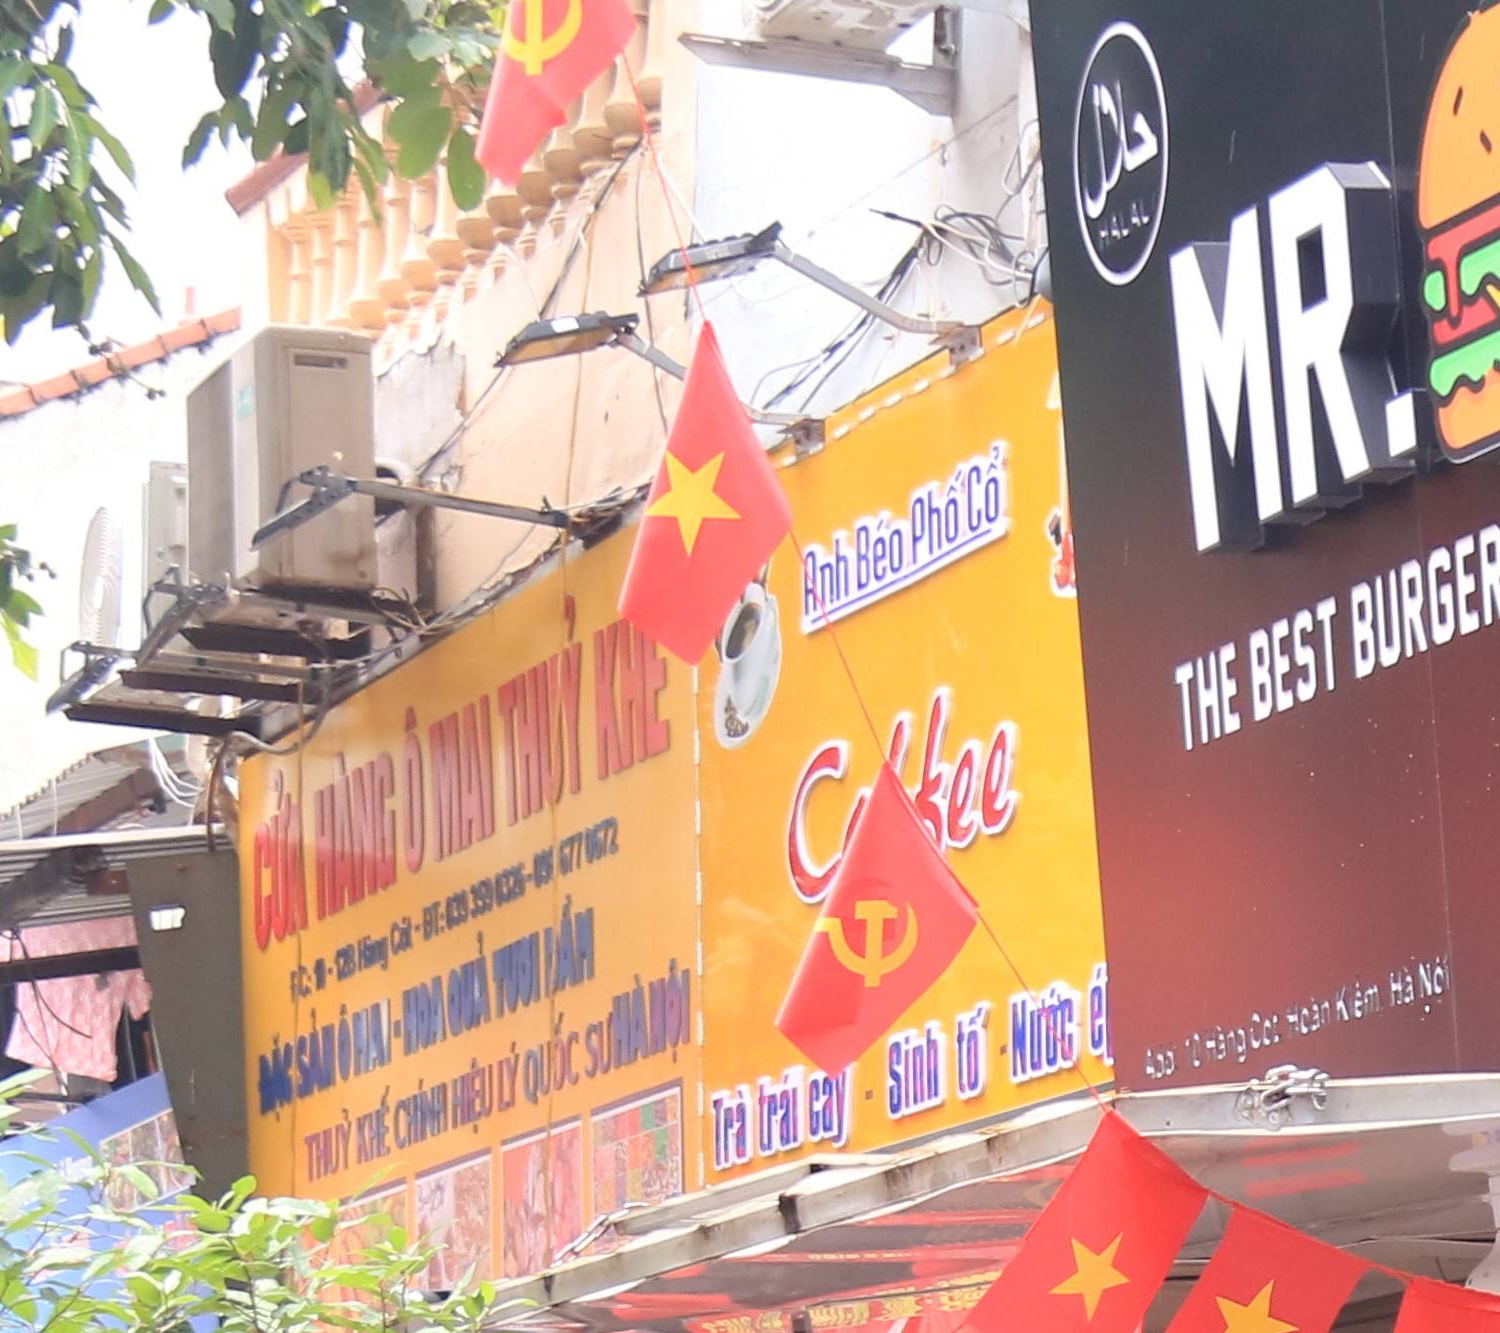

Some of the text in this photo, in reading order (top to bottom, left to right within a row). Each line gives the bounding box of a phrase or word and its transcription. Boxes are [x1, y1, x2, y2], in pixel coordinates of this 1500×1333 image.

[1169, 163, 1417, 553] MR.
[804, 534, 849, 616] Anh
[855, 518, 902, 591] Béo
[911, 470, 960, 566] Phố
[1174, 642, 1242, 750] THE
[1252, 598, 1337, 724] BEST
[315, 751, 397, 921] HÀNG
[429, 694, 496, 863] MAI
[393, 1078, 448, 1150] CHÍNH
[451, 1057, 494, 1135] HIỆU
[712, 1088, 748, 1169] Trà
[757, 1068, 799, 1152] trái
[888, 1028, 940, 1118] Sinh
